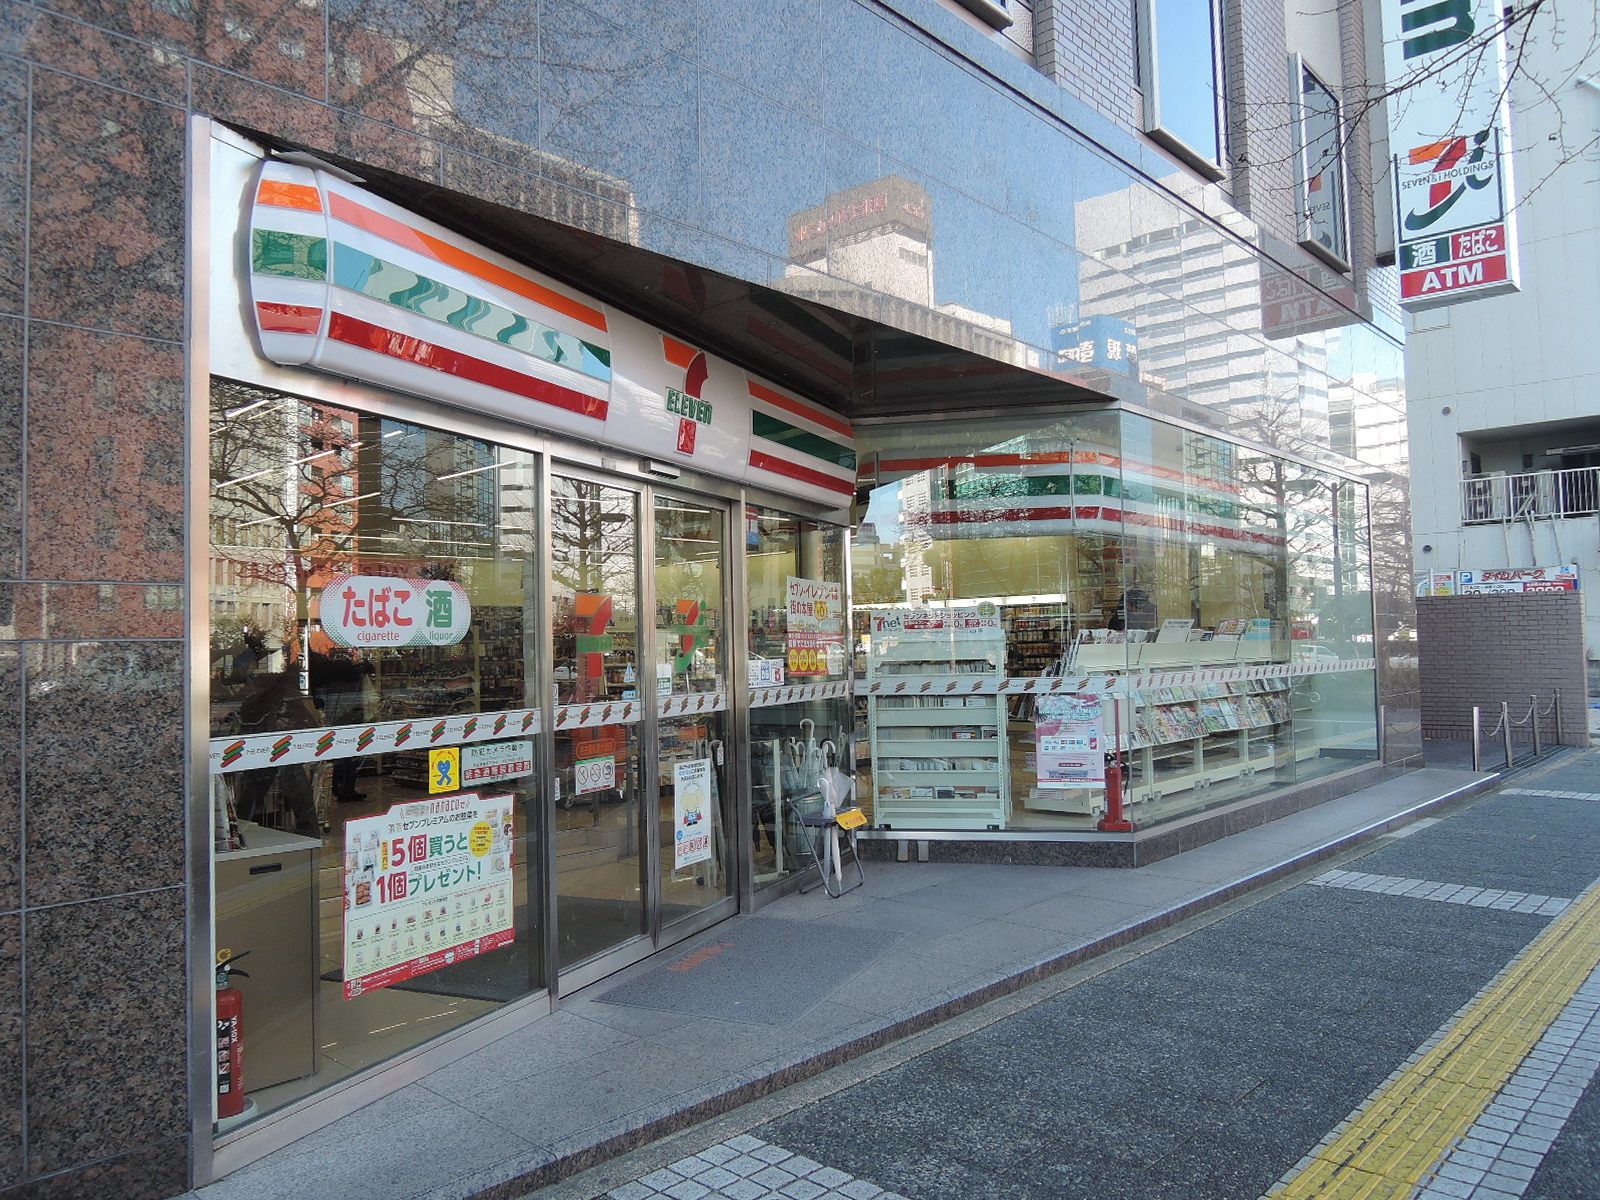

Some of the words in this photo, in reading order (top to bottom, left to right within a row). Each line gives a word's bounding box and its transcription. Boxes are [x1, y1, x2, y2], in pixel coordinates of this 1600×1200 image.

[1443, 161, 1494, 180] HOLDINGS
[1412, 240, 1437, 268] 酒
[1458, 229, 1499, 259] たばこ
[1421, 261, 1484, 293] ATM
[341, 585, 413, 629] たばこ
[425, 589, 453, 629] 酒
[873, 613, 901, 632] 7net
[357, 631, 400, 642] cigarette
[428, 631, 454, 643] liquor
[391, 832, 468, 868] 5個買うと
